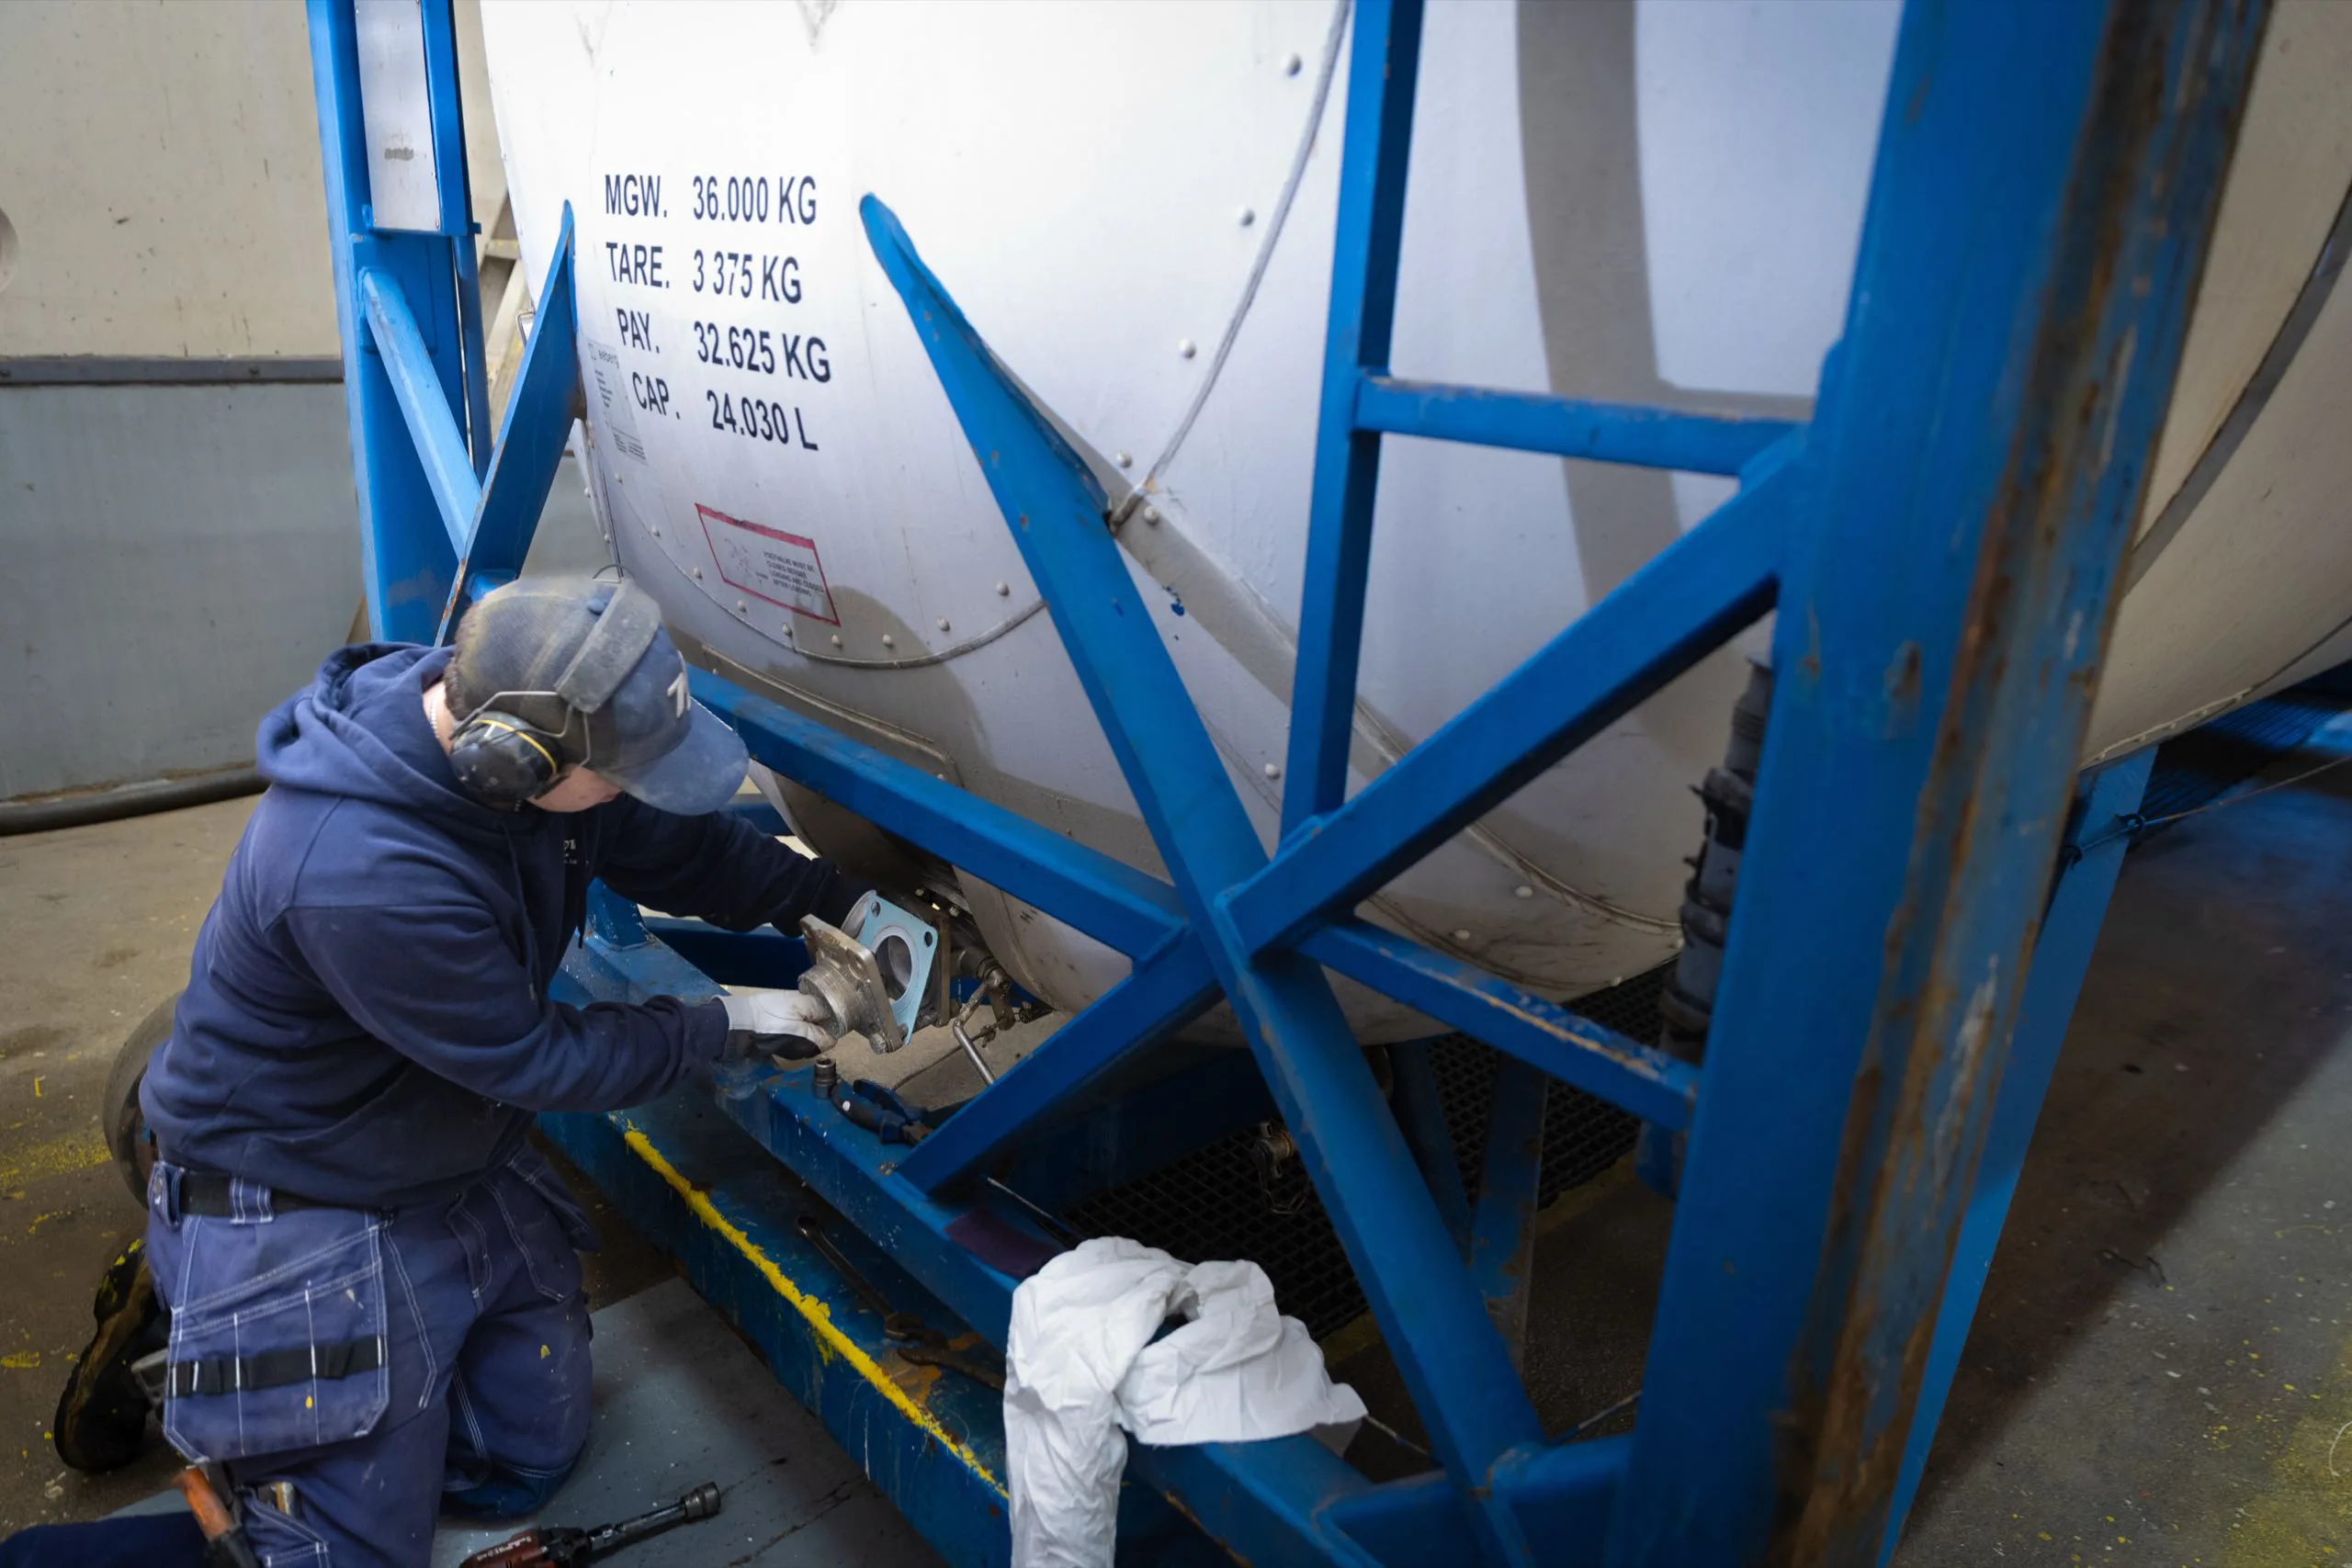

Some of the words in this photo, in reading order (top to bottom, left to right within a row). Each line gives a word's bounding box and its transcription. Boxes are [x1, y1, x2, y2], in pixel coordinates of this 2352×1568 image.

[605, 175, 668, 218] MGW.
[693, 175, 768, 223] 36.000
[779, 175, 817, 225] KG
[605, 242, 670, 288] TARE.
[762, 255, 802, 304] KG
[616, 308, 661, 354] PAY.
[694, 321, 775, 375] 32.625
[782, 333, 831, 383] KG
[707, 389, 789, 445] 24.030
[794, 407, 819, 452] L
